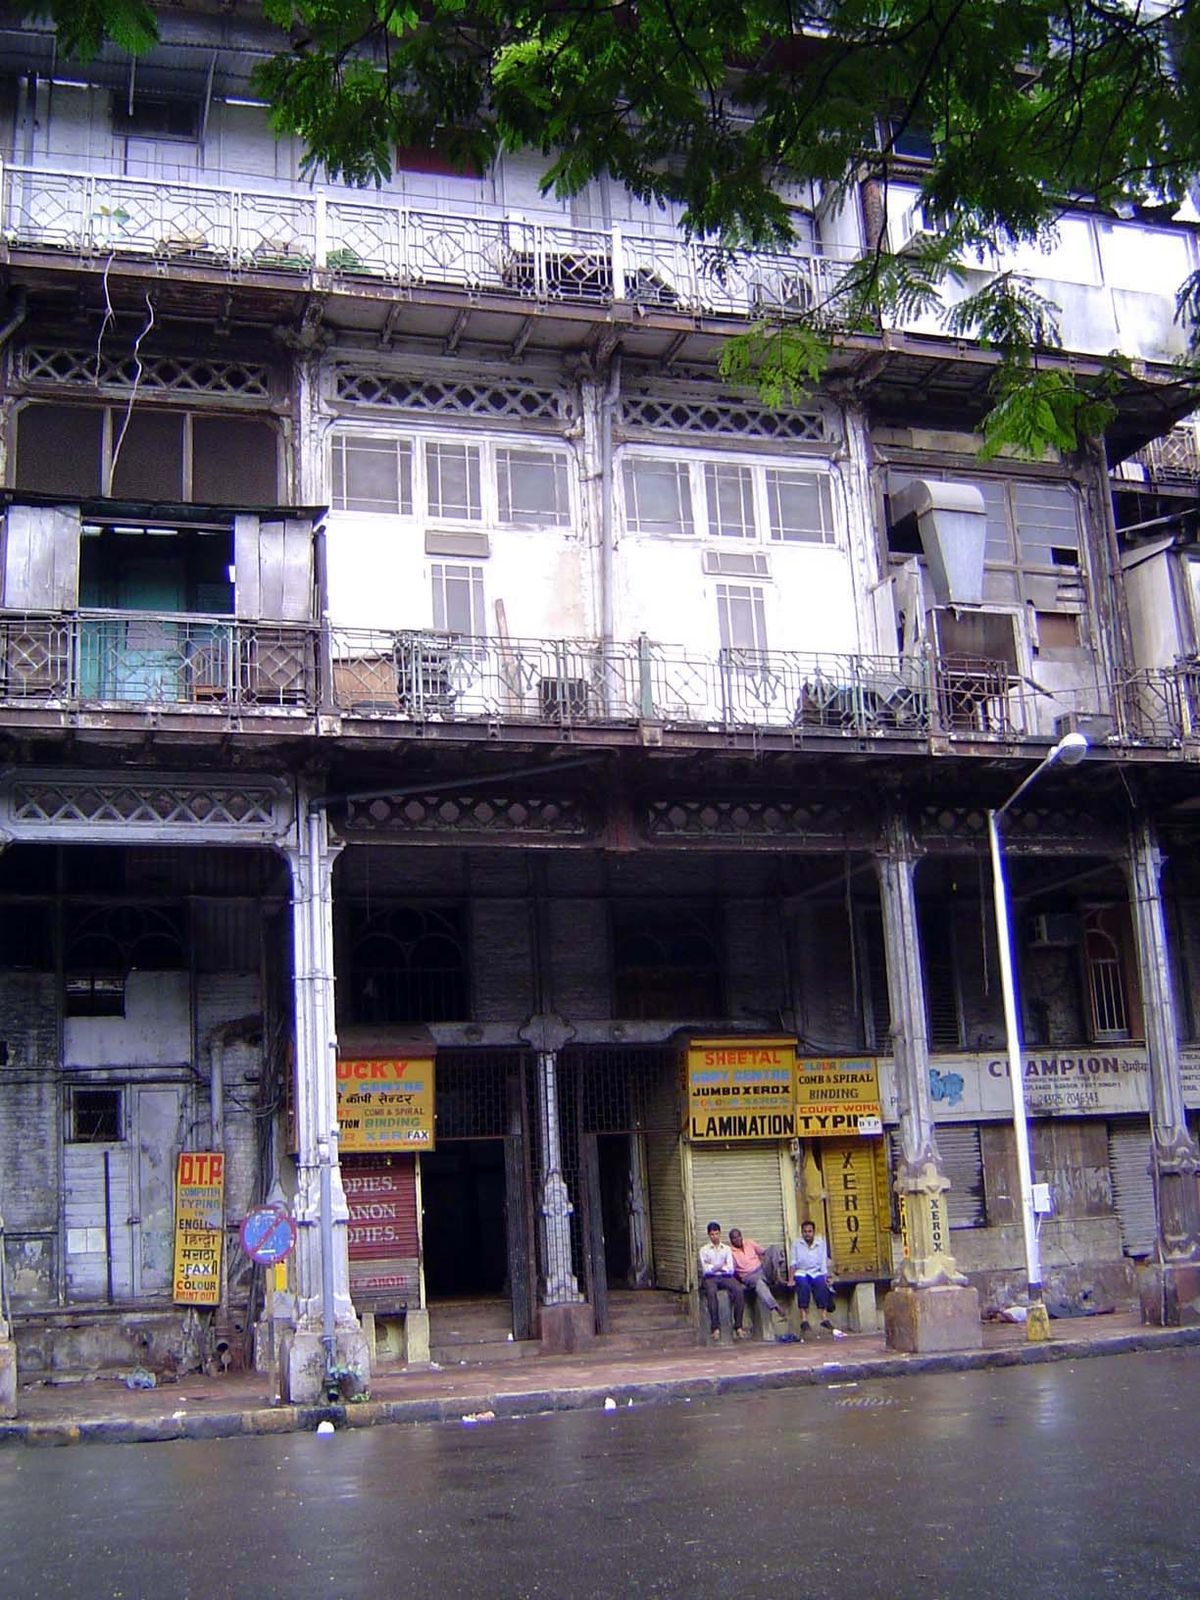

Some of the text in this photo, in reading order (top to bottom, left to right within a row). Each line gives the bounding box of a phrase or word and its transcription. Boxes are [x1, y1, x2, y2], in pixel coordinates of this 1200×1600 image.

[705, 1050, 781, 1066] SHEETAL
[336, 1062, 409, 1079] UCKY
[799, 1075, 824, 1085] COMB
[833, 1073, 874, 1084] SPIRAL
[692, 1085, 790, 1097] JUMBO XEROX
[809, 1089, 859, 1099] BINDING
[395, 1107, 424, 1116] SPIRAL
[800, 1105, 839, 1114] COURT
[843, 1103, 879, 1112] WORK
[364, 1117, 420, 1129] BINDING
[692, 1114, 794, 1138] LAMINATION
[407, 1130, 429, 1139] FAX
[180, 1155, 223, 1185] D.T.P.
[343, 1175, 398, 1193] OPIES.
[180, 1199, 221, 1209] TYPING
[841, 1151, 860, 1254] XEROX
[349, 1203, 397, 1220] ANON
[930, 1199, 942, 1252] XEROX
[186, 1263, 210, 1274] FAX
[176, 1281, 216, 1290] COLOUR
[175, 1290, 216, 1301] PRINT OUT
